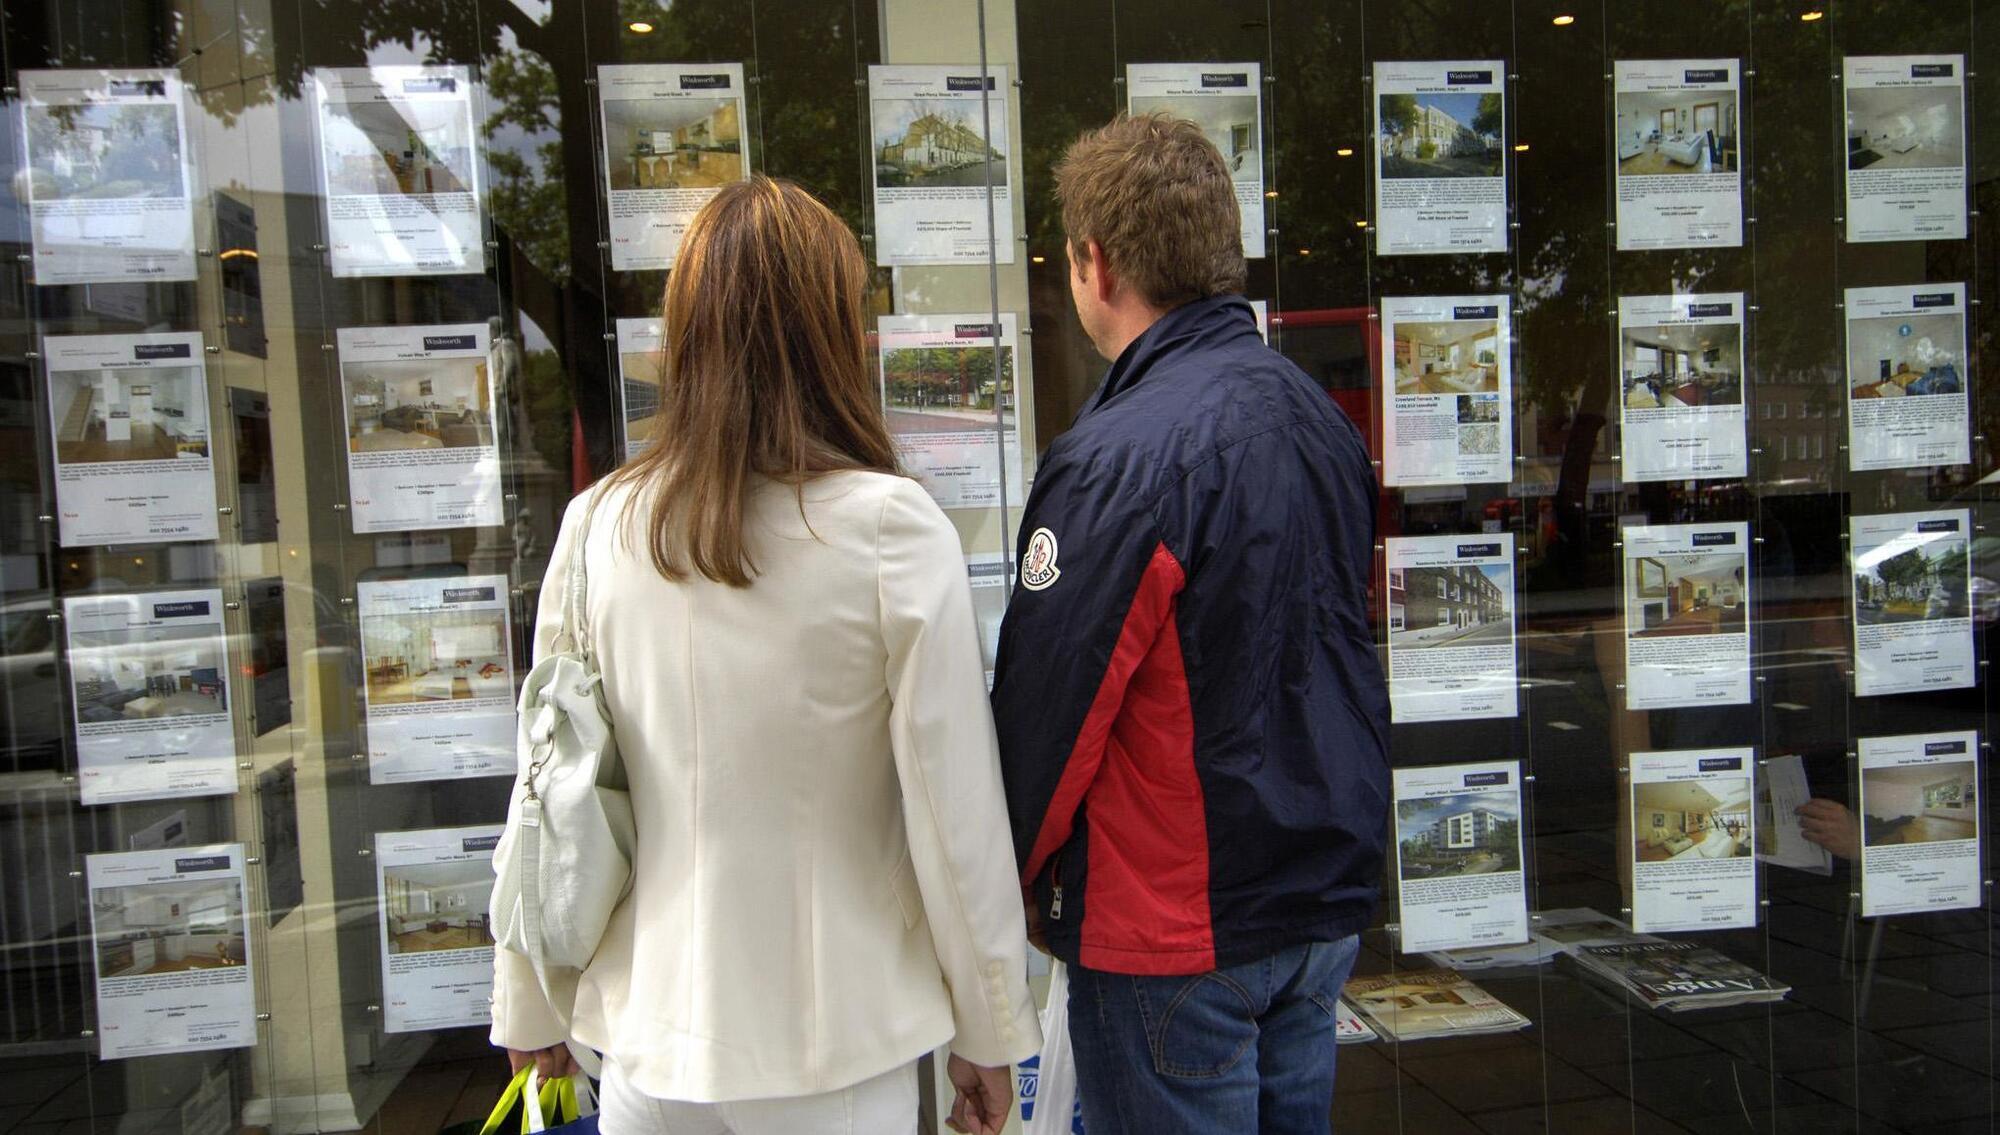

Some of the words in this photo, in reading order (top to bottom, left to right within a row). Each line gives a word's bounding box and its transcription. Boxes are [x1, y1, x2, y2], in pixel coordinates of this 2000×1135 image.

[1203, 74, 1234, 82] Winkworth
[1449, 72, 1480, 80] Winkworth
[1686, 71, 1716, 79] Winkworth
[681, 75, 716, 84] Winkworth
[948, 78, 982, 86] Winkworth
[956, 324, 989, 333] Winkworth
[425, 337, 462, 346] Winkworth
[135, 344, 175, 354] Winkworth
[1458, 545, 1489, 553] Winkworth
[445, 589, 480, 598] Winkworth
[155, 604, 194, 613] Winkworth
[1700, 759, 1730, 767] Winkworth
[1465, 774, 1496, 782] Winkworth
[177, 859, 215, 867] Winkworth
